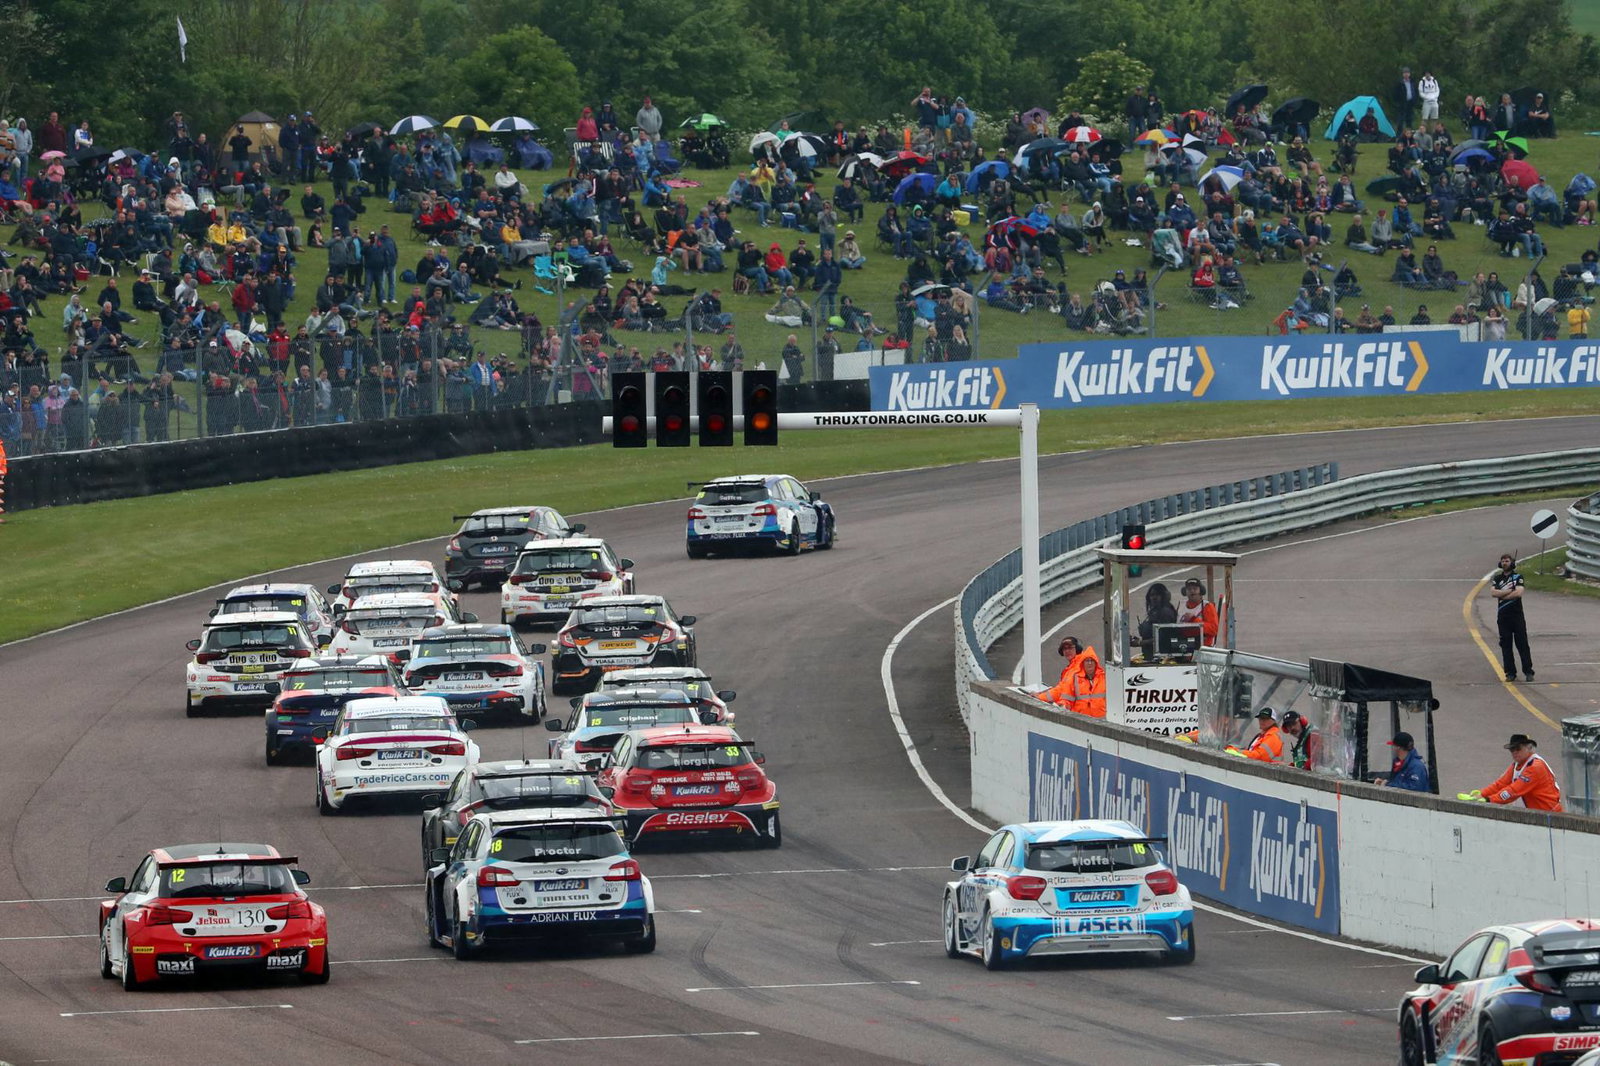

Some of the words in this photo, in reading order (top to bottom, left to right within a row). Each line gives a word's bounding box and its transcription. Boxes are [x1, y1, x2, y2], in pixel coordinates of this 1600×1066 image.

[814, 413, 987, 425] THRUXTONRACING.CO.UK
[287, 626, 297, 636] 11
[294, 682, 305, 690] 77
[1125, 704, 1186, 714] Motorsport
[725, 746, 740, 757] 33
[354, 773, 450, 785] TradePriceCars.com
[666, 811, 729, 822] Ciceley
[490, 839, 502, 854] 18
[534, 847, 581, 857] Proctor
[172, 868, 186, 883] 12
[196, 916, 230, 926] Jelson
[237, 908, 265, 928] 130
[531, 913, 569, 923] ADRIAN
[573, 911, 597, 921] FLUX
[1064, 916, 1134, 934] LASER
[157, 956, 196, 971] maxi
[267, 950, 305, 966] maxi
[1557, 1036, 1600, 1050] SIMP
